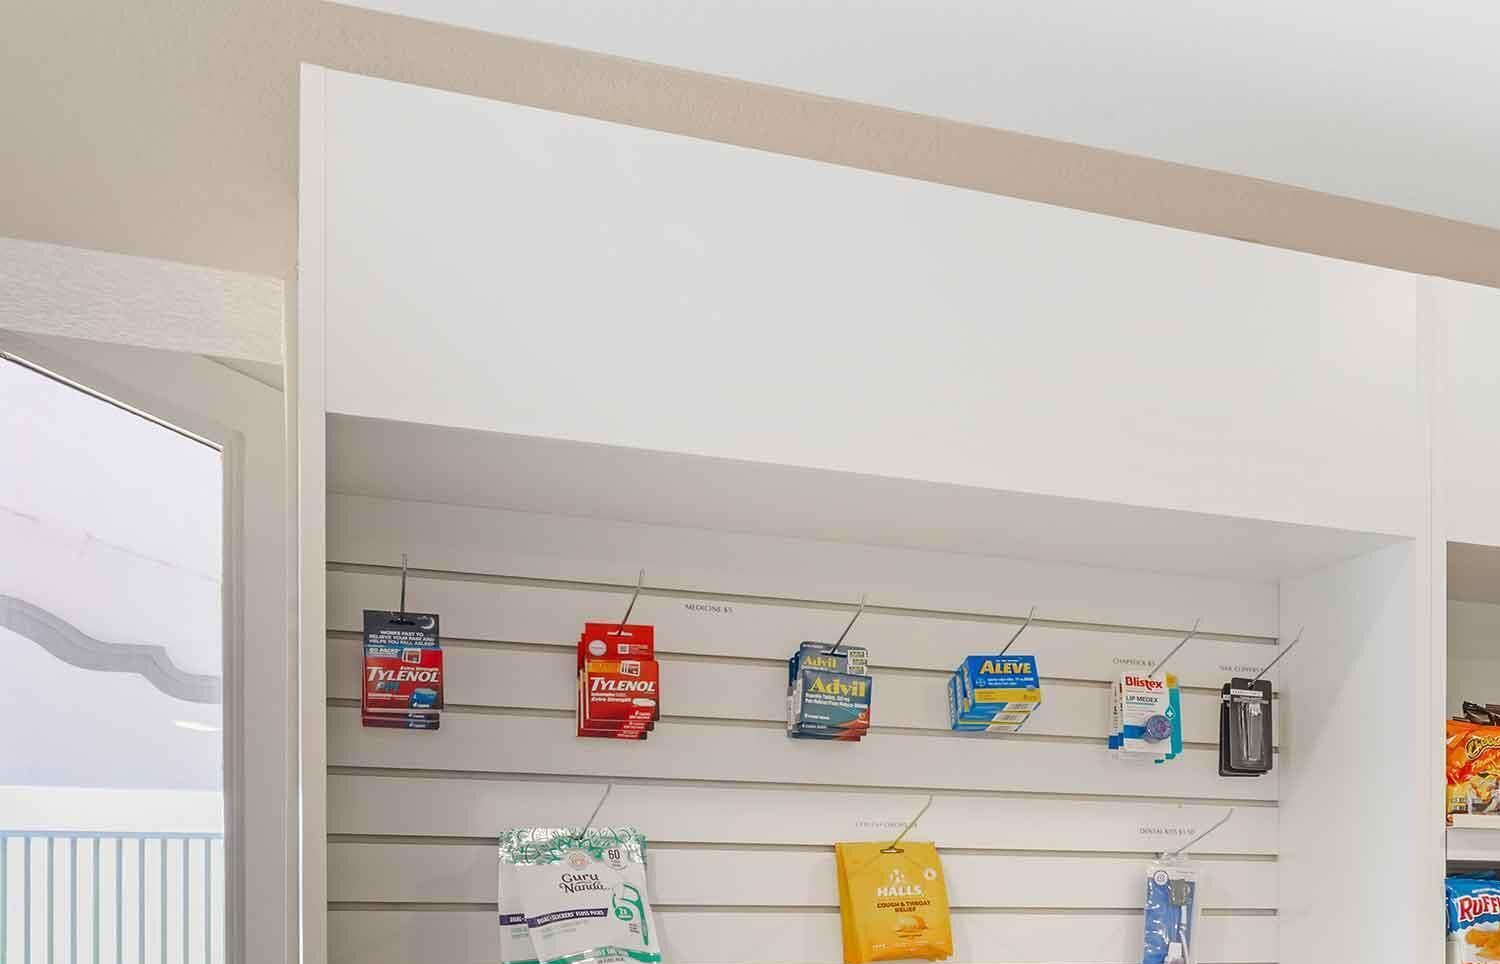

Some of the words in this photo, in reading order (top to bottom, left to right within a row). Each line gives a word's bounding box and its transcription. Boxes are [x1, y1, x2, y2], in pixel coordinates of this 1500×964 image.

[803, 656, 837, 668] Advil
[979, 660, 1032, 674] ALEVE
[368, 666, 440, 682] TYLENOL
[590, 677, 656, 692] TYLENOL
[807, 676, 866, 698] Advil
[1125, 676, 1163, 690] Blistex
[608, 850, 620, 860] 60
[562, 872, 600, 884] Guru
[559, 881, 607, 894] Nanda
[876, 886, 922, 896] HALLS
